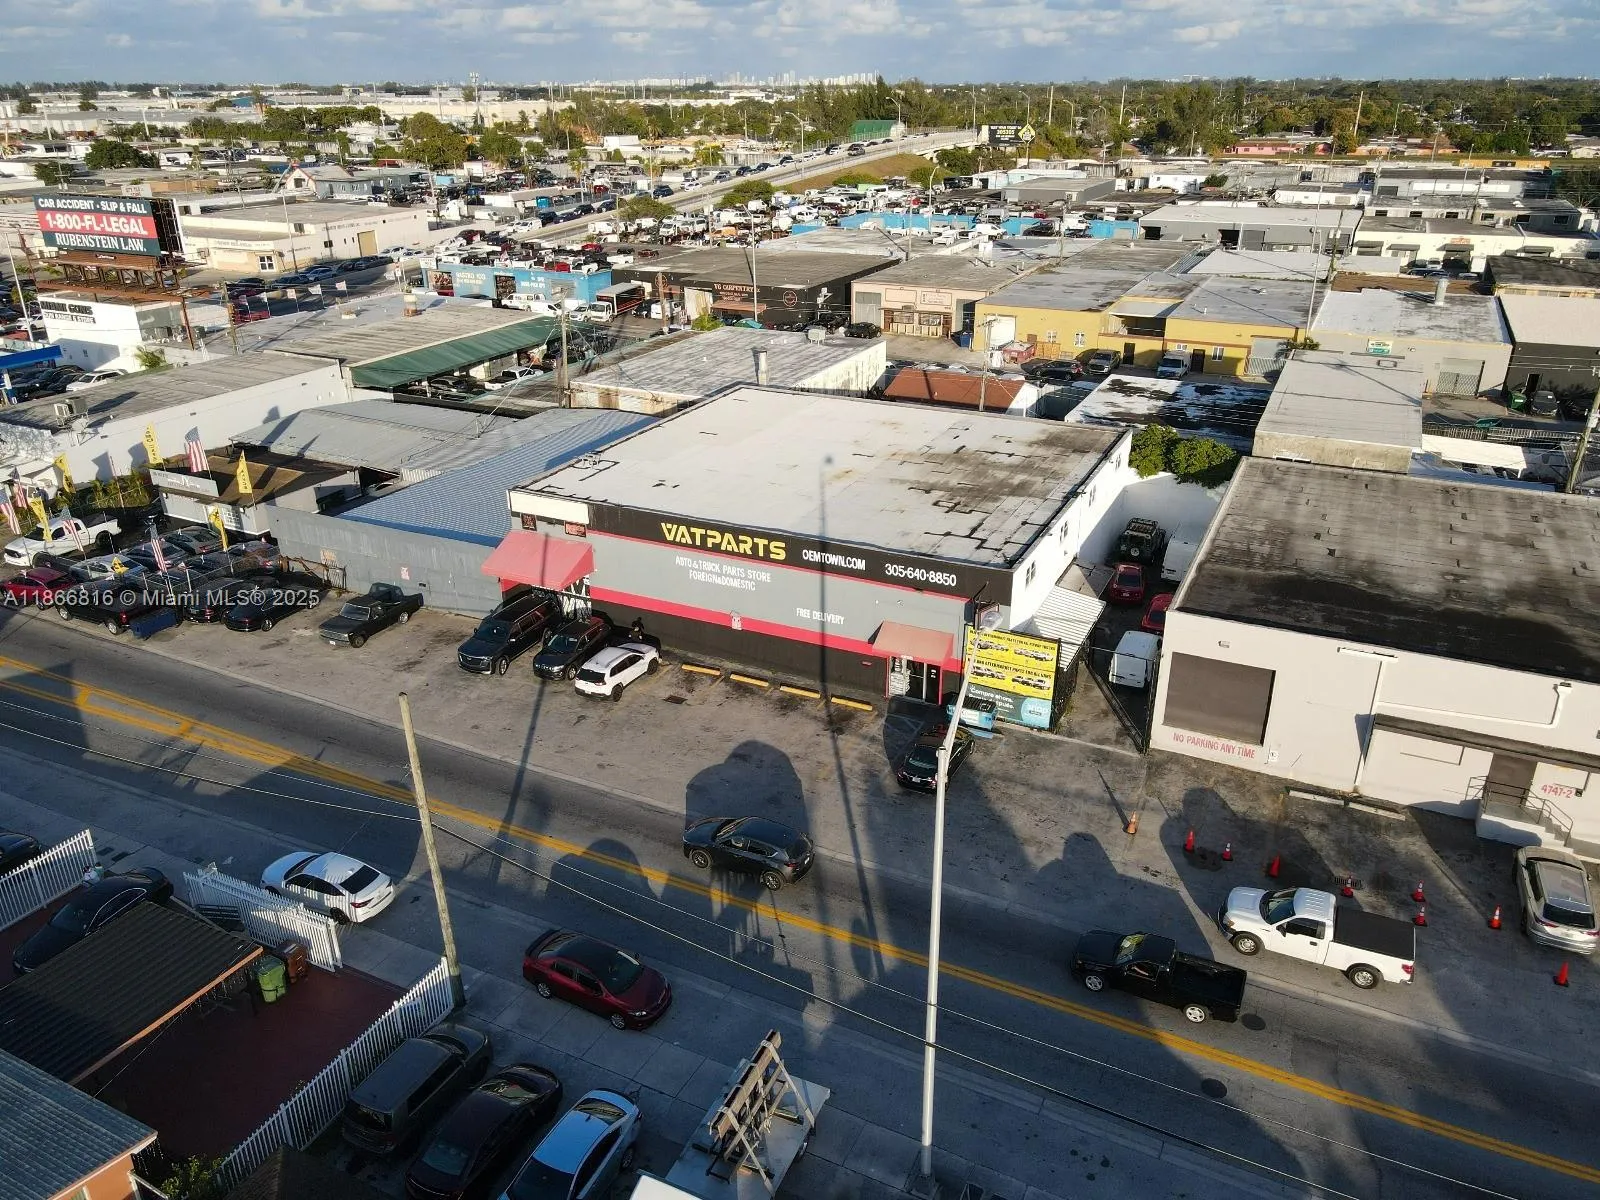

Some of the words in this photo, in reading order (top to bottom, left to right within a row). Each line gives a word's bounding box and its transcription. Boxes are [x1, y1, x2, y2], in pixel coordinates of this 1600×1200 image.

[38, 198, 55, 207] CAR
[56, 199, 94, 210] ACCIDENT
[100, 201, 118, 211] SLIP
[119, 202, 126, 212] &
[127, 202, 147, 214] FALL
[45, 212, 148, 235] 1-800-FL-LEGAL
[55, 232, 119, 249] RUBENSTEIN
[120, 238, 147, 252] LAW.
[660, 522, 787, 561] VATPARTS
[675, 555, 692, 567] AUTO
[692, 560, 699, 568] &
[698, 559, 720, 574] TRUCK
[722, 564, 745, 578] PARTS
[747, 569, 771, 583] STORE
[802, 549, 866, 571] OEMTOWN.COM
[796, 607, 811, 619] FREE
[812, 610, 845, 625] DELIVERY
[1173, 732, 1184, 743] NO
[1186, 735, 1219, 750] PARKING
[1220, 743, 1236, 754] ANY
[1237, 746, 1256, 759] TIME
[1541, 784, 1573, 799] 4747-2
